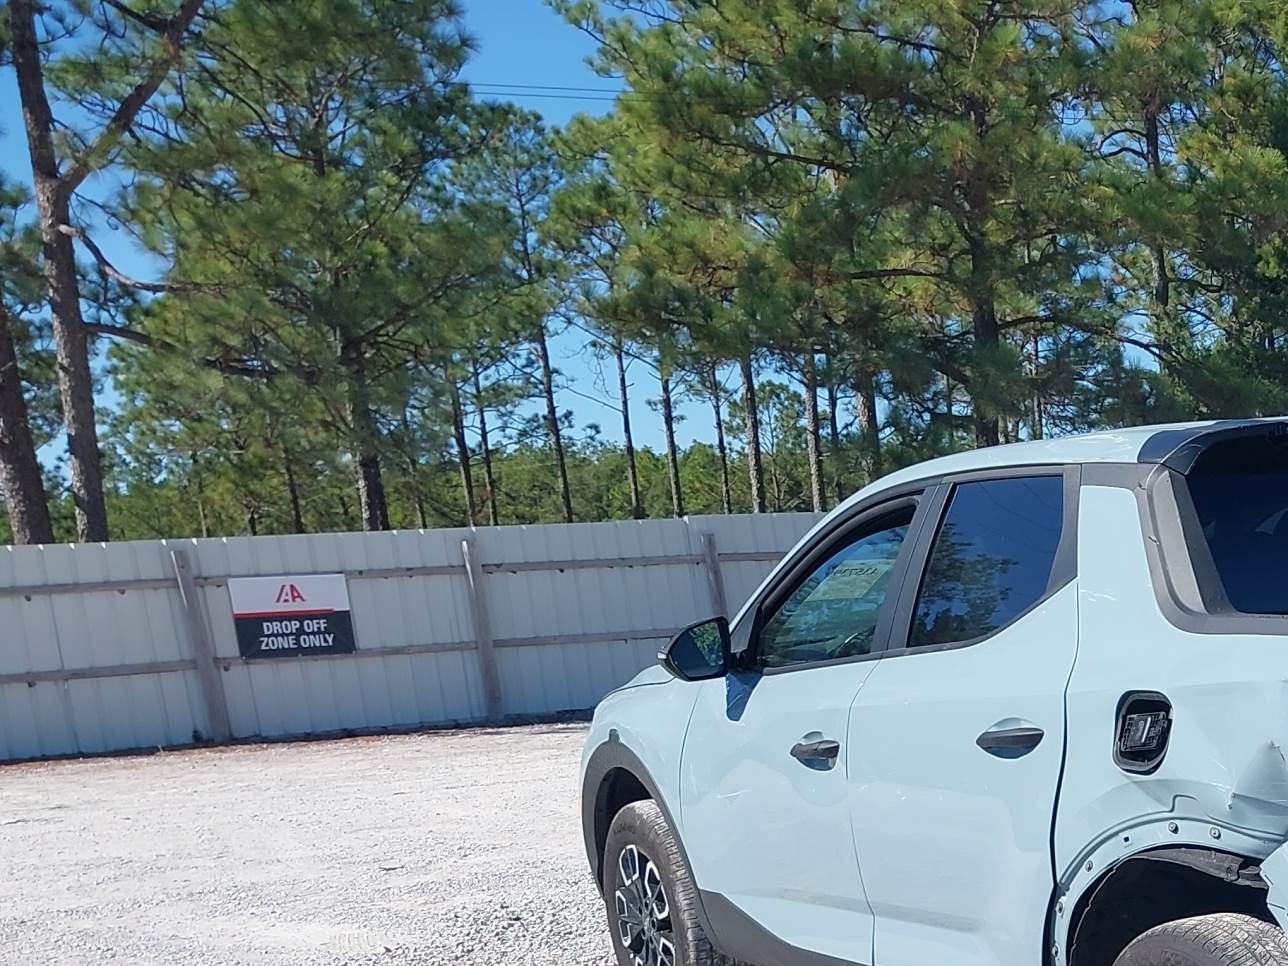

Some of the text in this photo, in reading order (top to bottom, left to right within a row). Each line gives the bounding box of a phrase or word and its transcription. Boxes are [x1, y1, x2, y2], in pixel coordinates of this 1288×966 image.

[263, 619, 327, 635] DROP OFF
[260, 634, 334, 650] ZONE ONLY
